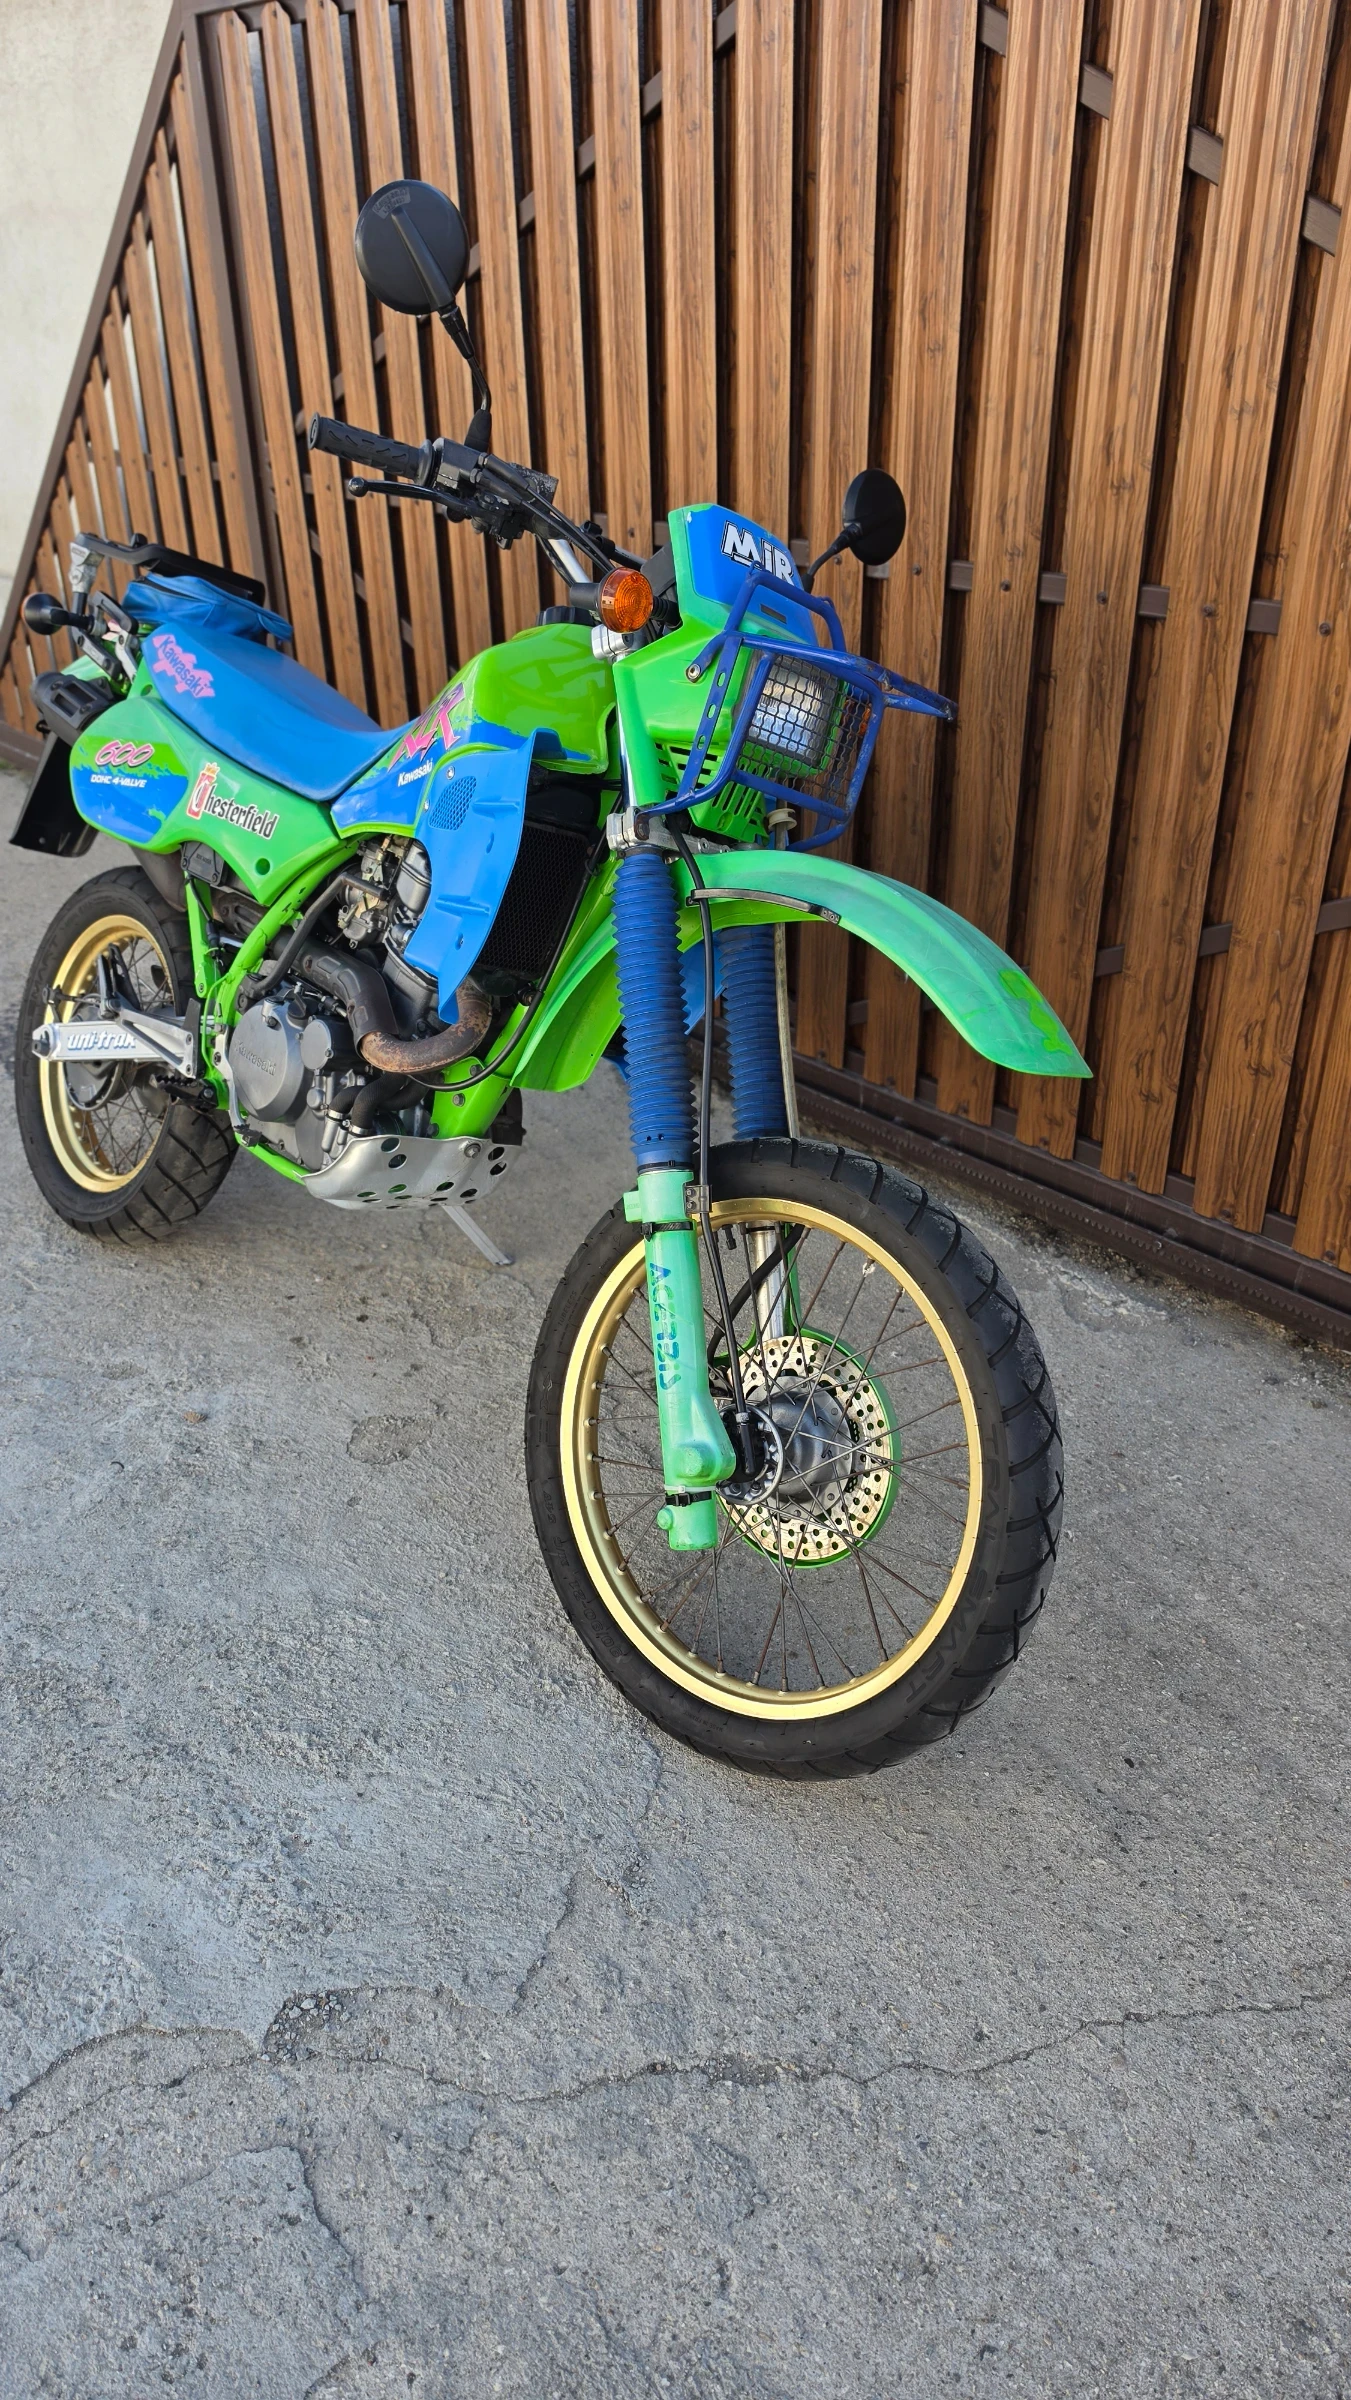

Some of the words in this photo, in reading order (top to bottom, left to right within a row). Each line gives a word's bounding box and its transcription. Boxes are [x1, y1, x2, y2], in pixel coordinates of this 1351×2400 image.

[158, 635, 207, 697] Kawasaki
[95, 740, 154, 767] 600
[90, 774, 112, 785] DOHC
[112, 776, 147, 788] 4-VALVE
[397, 759, 434, 787] Kawasaki
[190, 777, 278, 838] Chesterfield
[234, 1041, 277, 1077] Kawasaki
